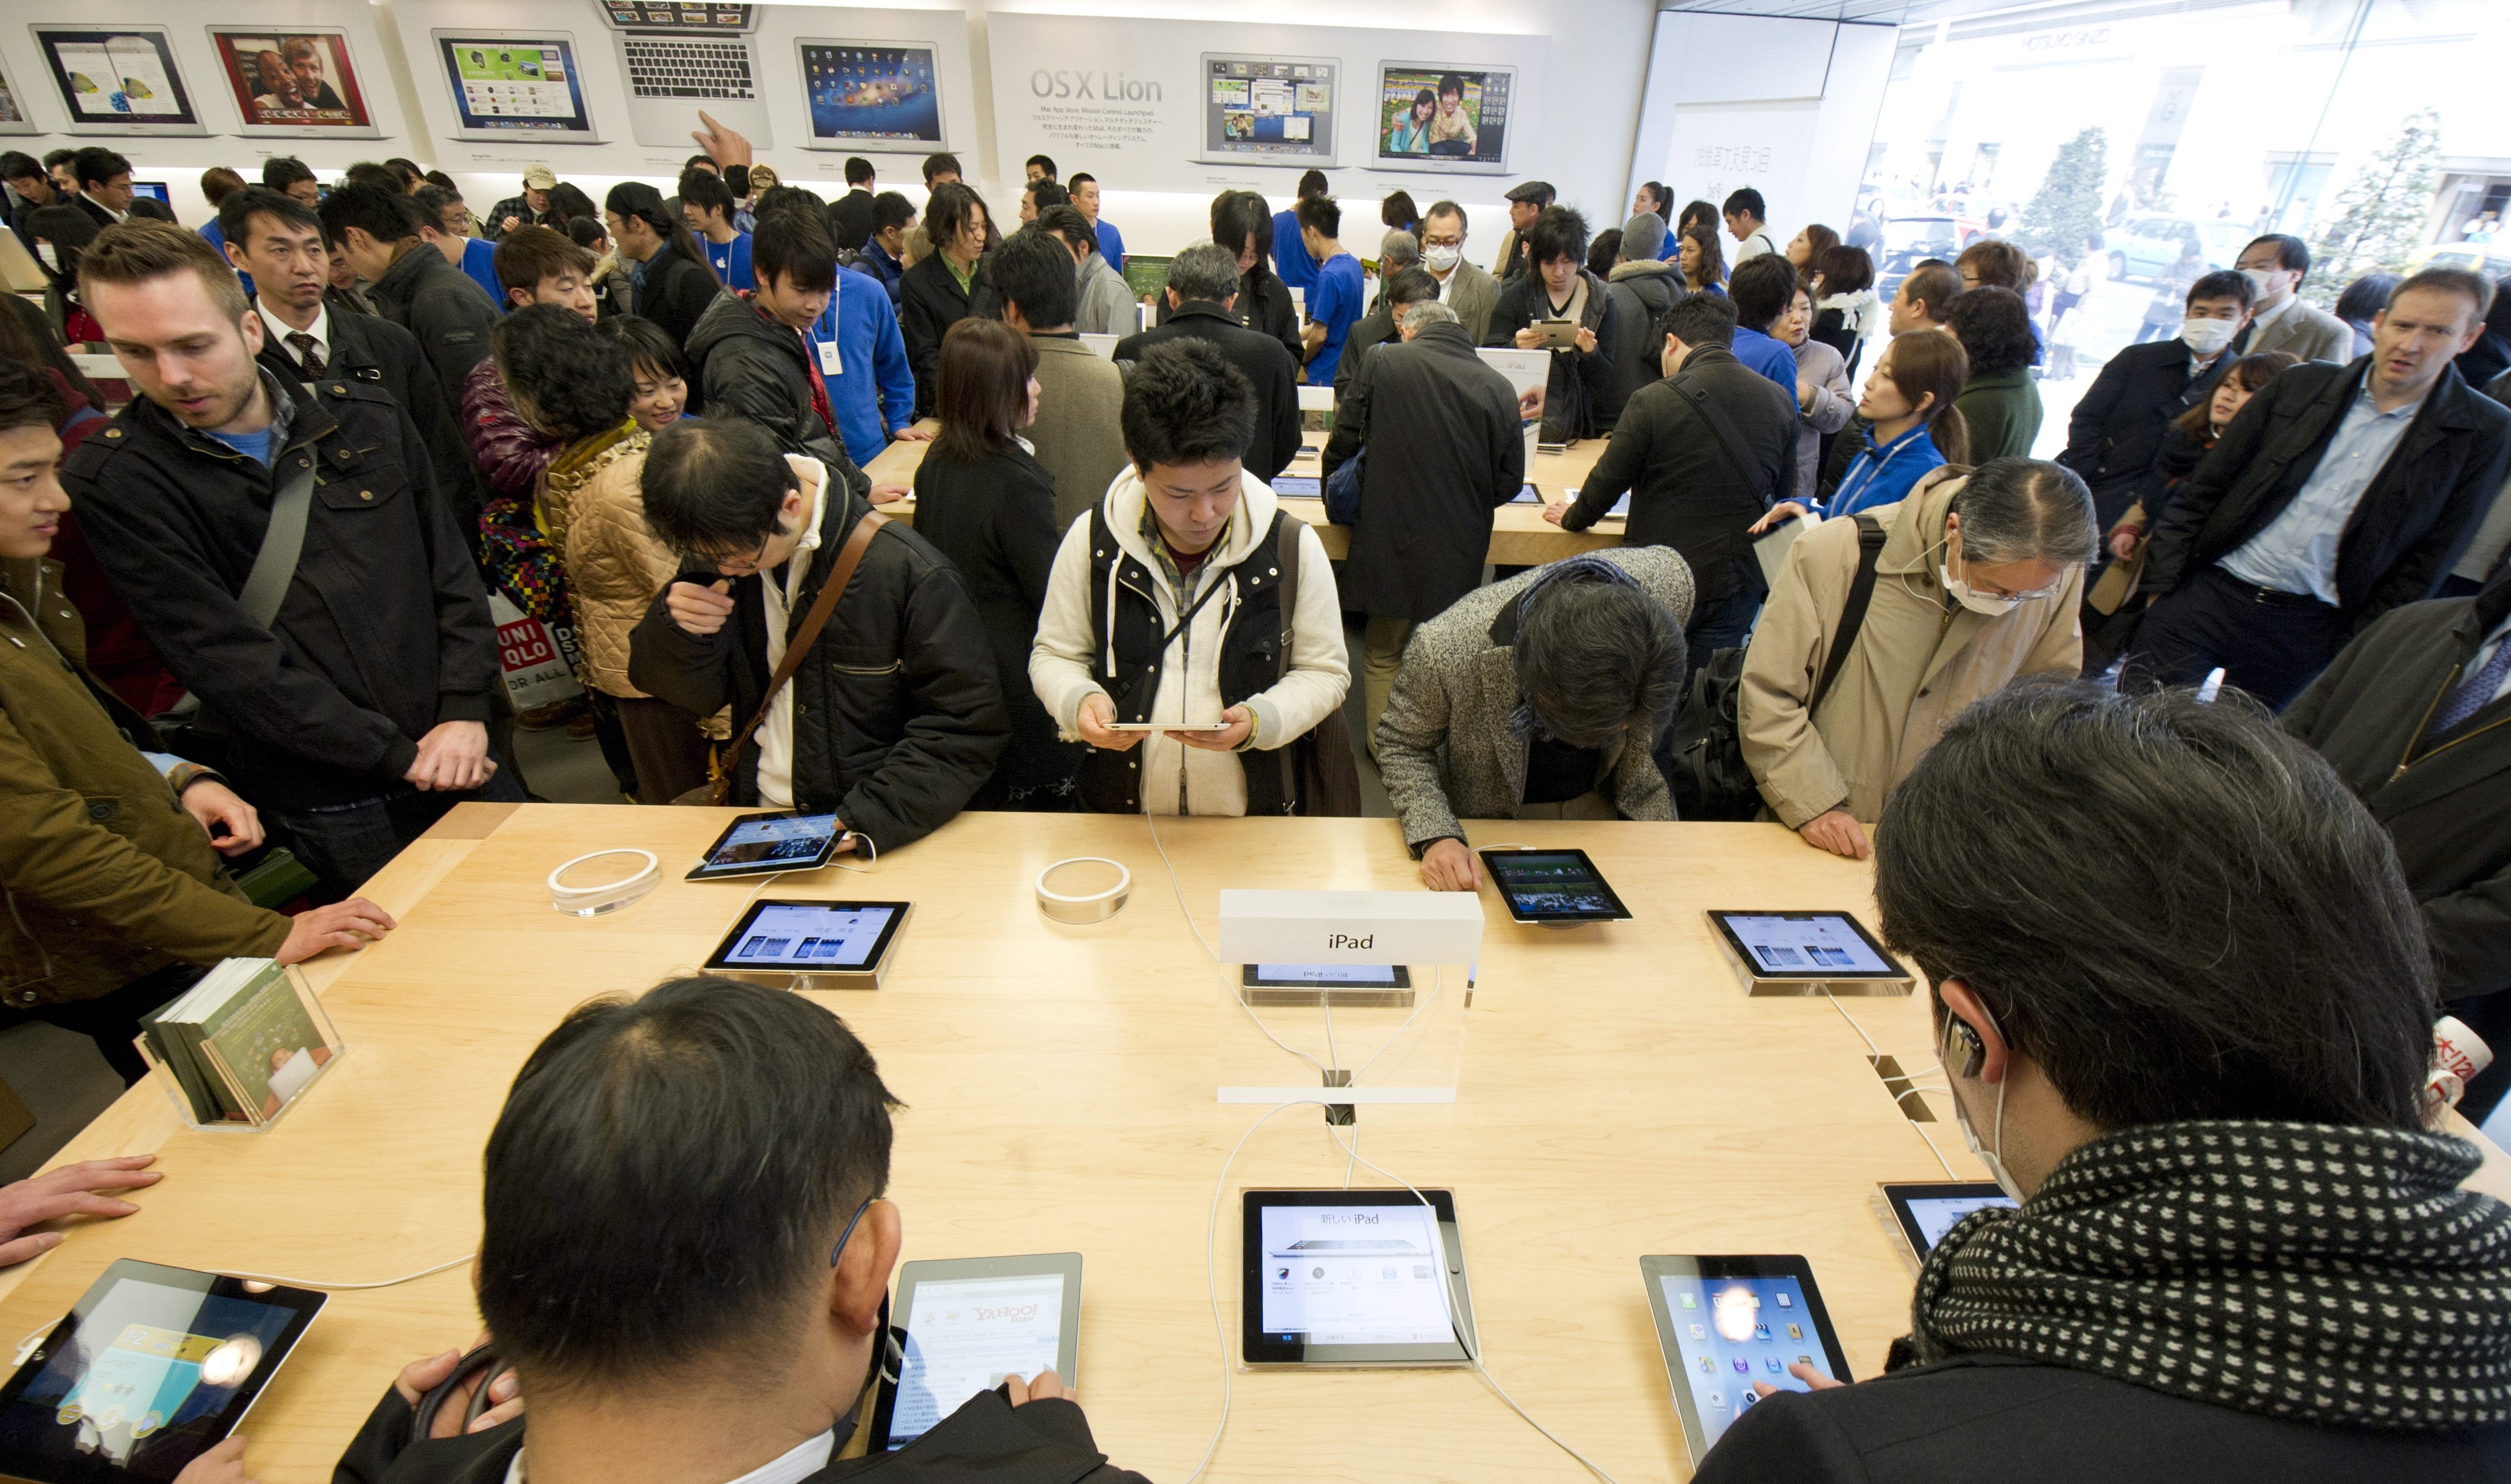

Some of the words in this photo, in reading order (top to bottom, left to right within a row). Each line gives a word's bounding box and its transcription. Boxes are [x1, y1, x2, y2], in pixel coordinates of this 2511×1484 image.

[1074, 70, 1095, 100] X
[1102, 71, 1162, 102] Lion
[1508, 359, 1526, 369] iPad
[498, 624, 538, 647] UNI
[505, 641, 548, 666] QLO
[536, 669, 567, 684] ALL
[1328, 934, 1374, 949] iPad
[1354, 1213, 1379, 1225] iPad
[972, 1303, 1038, 1321] YAHOO!
